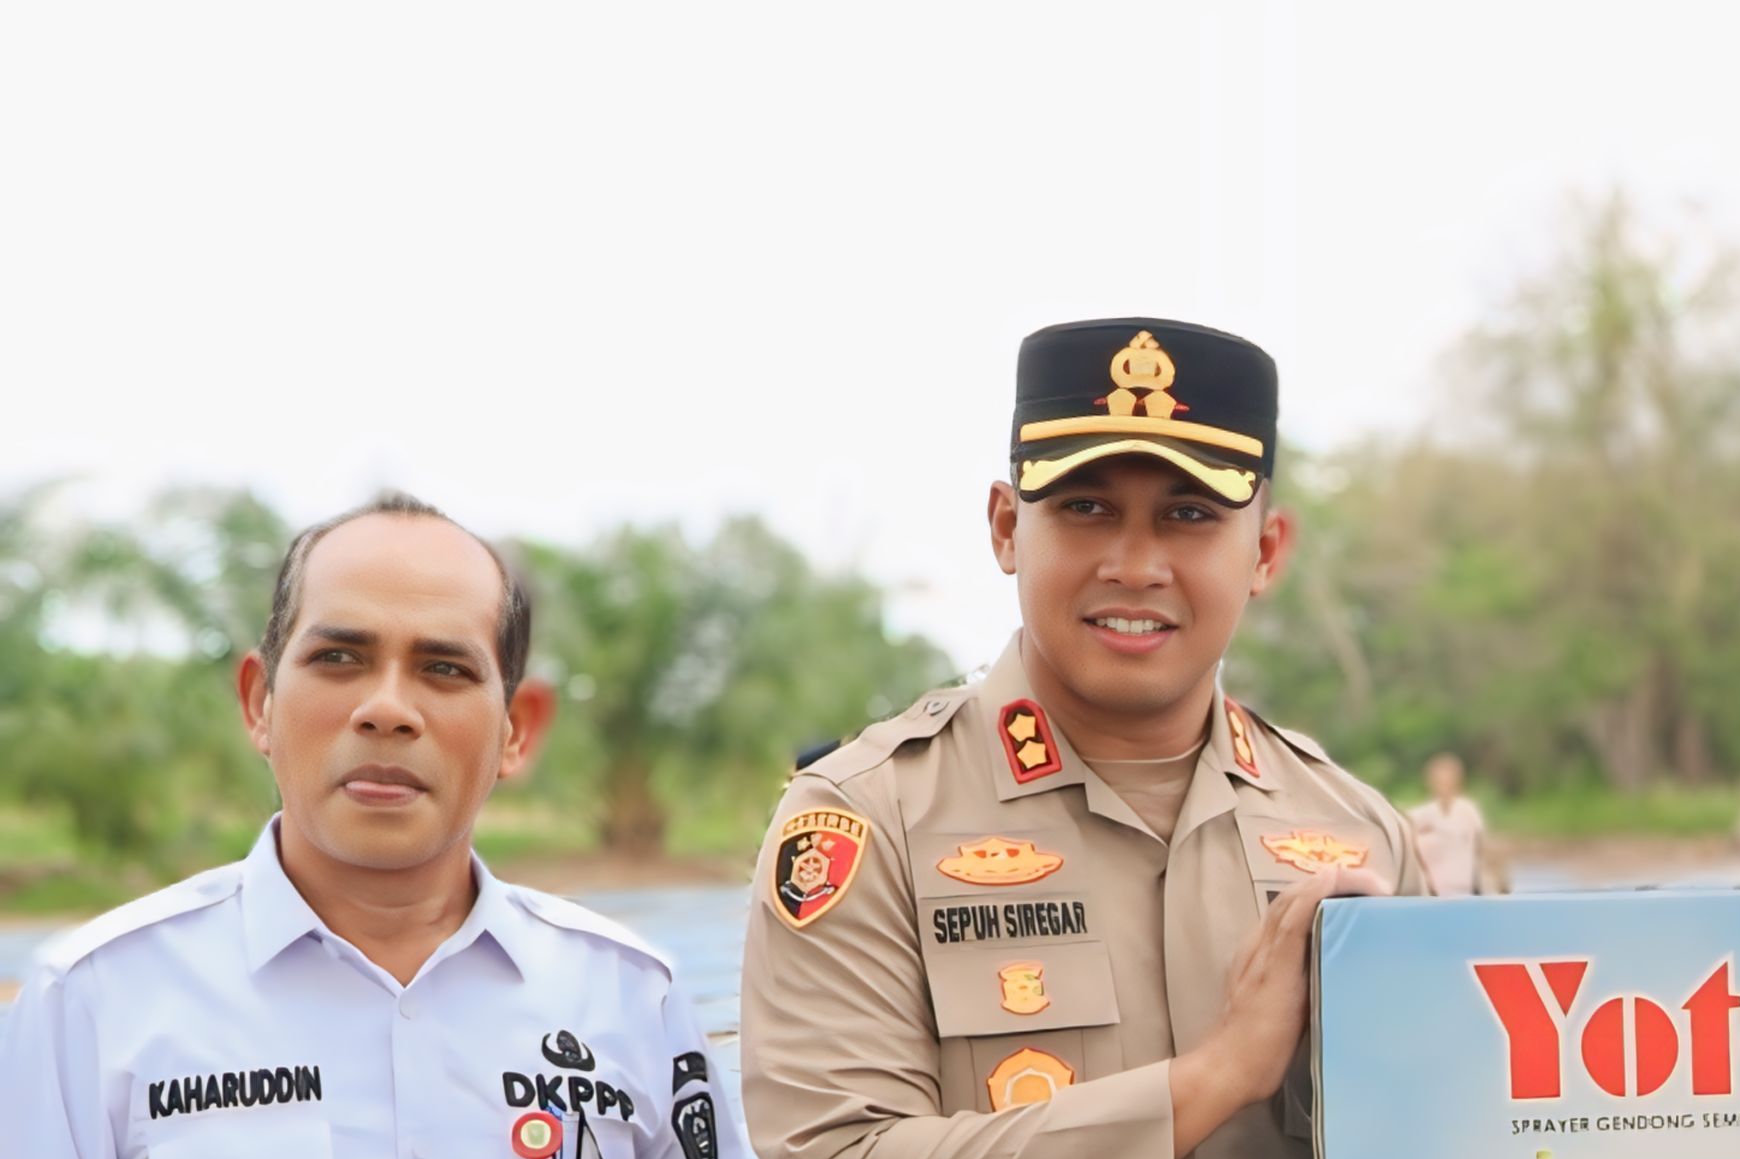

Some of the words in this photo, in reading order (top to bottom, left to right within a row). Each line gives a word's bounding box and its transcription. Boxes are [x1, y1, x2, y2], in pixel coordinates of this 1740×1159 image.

[933, 904, 1001, 944] SEPUH
[1004, 901, 1088, 938] SIREGAR
[149, 1065, 322, 1120] KAHARUDDIN
[1511, 1117, 1590, 1135] SPRAYER
[1597, 1113, 1695, 1131] GENDONG
